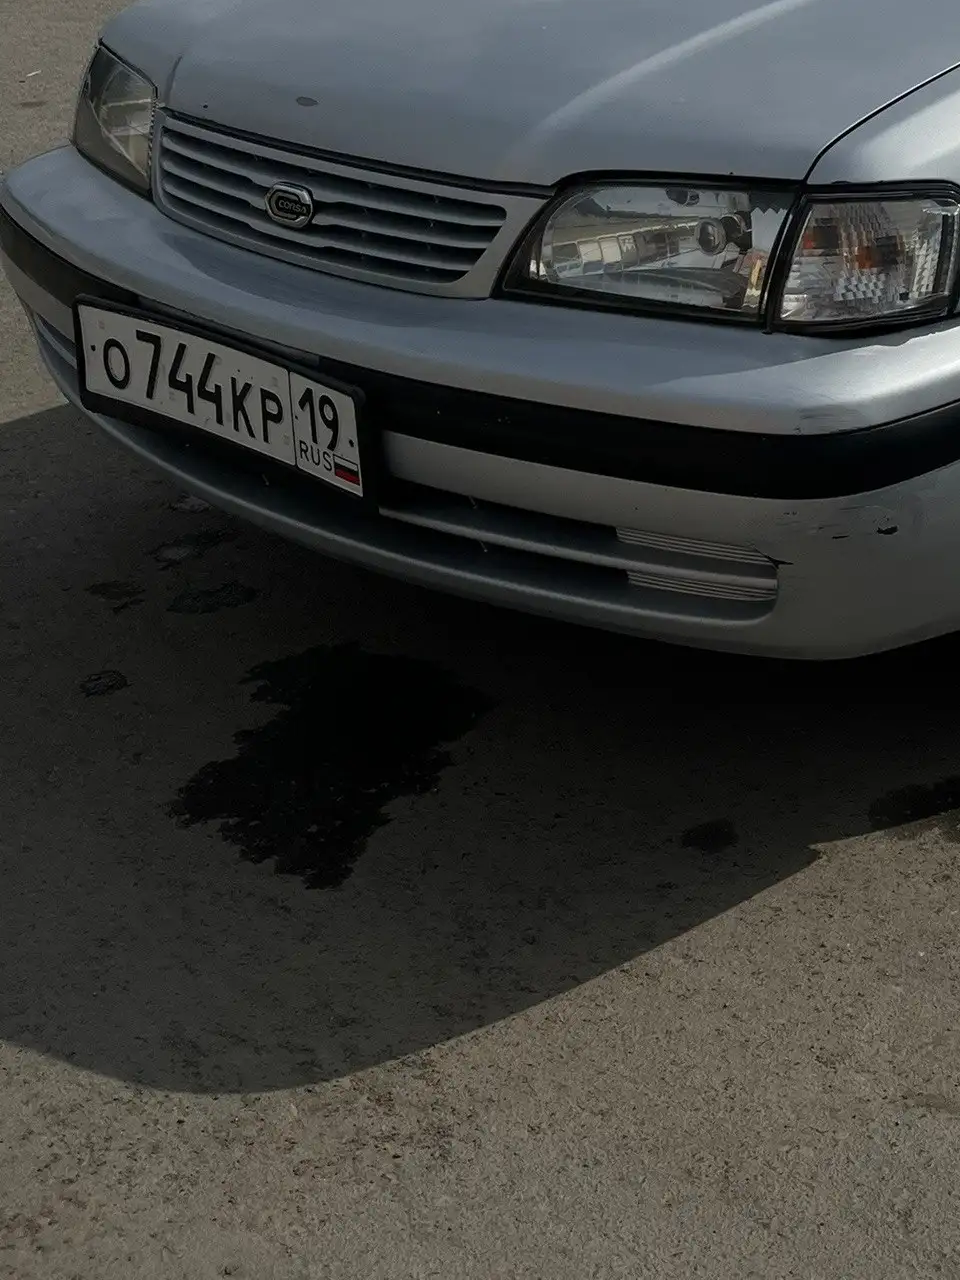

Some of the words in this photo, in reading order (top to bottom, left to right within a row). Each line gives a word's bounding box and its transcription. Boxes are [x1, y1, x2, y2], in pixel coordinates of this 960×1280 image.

[278, 199, 307, 214] CORSA
[102, 329, 284, 445] О744КР
[298, 387, 339, 451] 19
[299, 439, 333, 471] RUS
